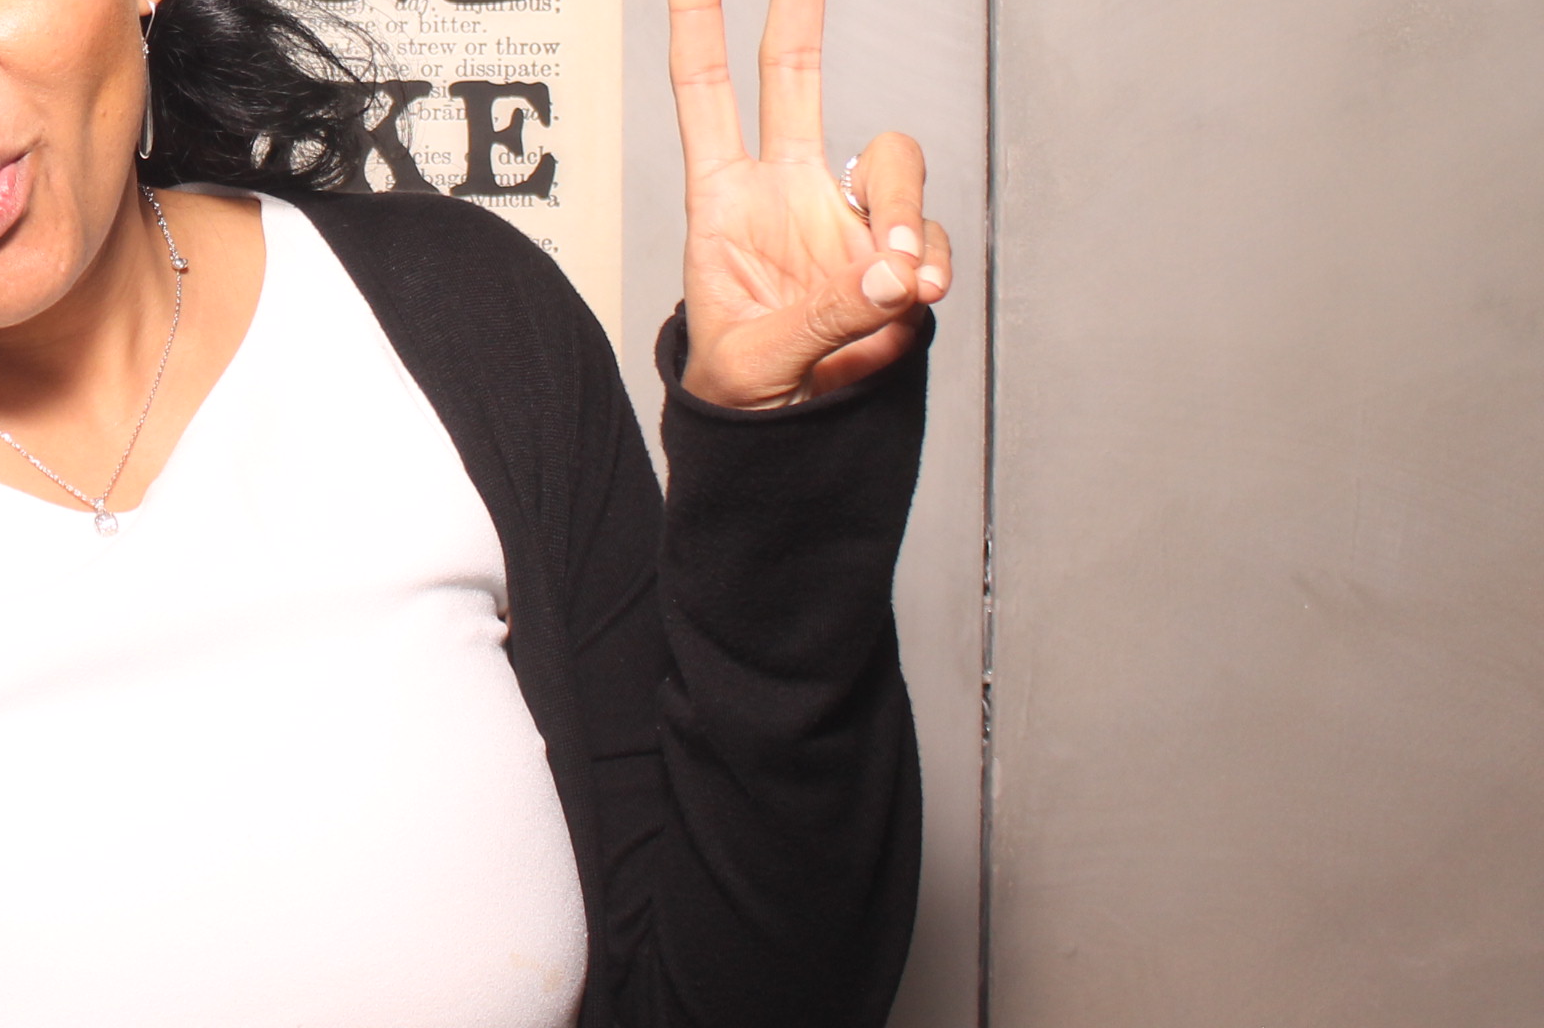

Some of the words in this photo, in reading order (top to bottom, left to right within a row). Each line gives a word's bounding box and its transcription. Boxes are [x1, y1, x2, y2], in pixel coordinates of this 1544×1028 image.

[385, 19, 408, 34] or
[396, 39, 455, 56] strew
[464, 43, 488, 55] or
[495, 38, 561, 55] throw
[420, 63, 443, 78] or
[328, 80, 556, 199] KE
